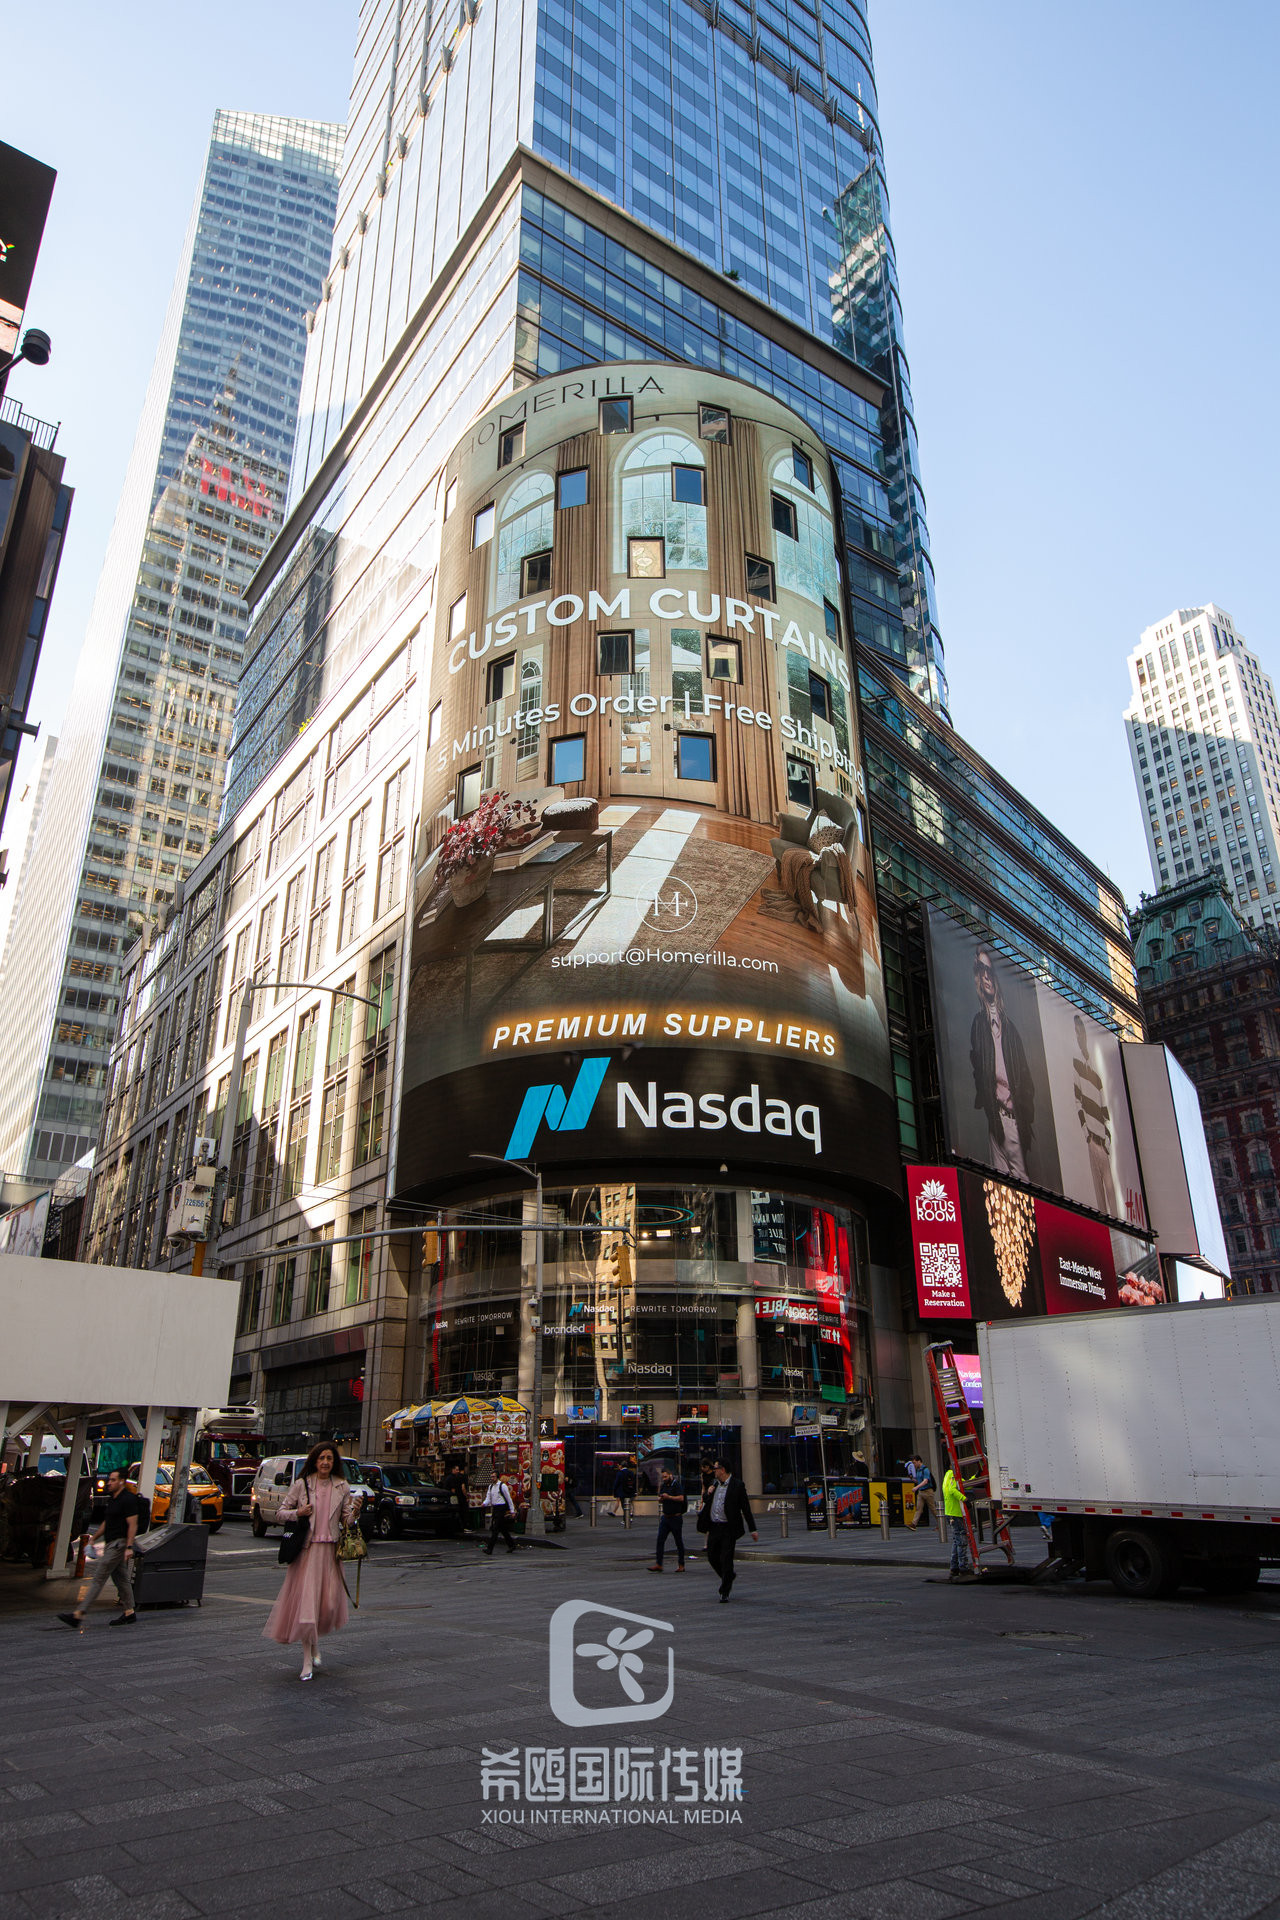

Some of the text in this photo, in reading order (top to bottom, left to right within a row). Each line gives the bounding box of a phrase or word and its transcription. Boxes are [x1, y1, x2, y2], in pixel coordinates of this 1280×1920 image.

[459, 375, 666, 461] HOMERILLA
[447, 588, 852, 694] CUSTOM CURTAINS
[437, 752, 448, 773] 5
[452, 704, 560, 756] Minutes
[570, 690, 673, 718] Order
[703, 693, 773, 731] Free
[780, 715, 866, 797] Shipping
[550, 947, 780, 974] support@Homerilla.com
[492, 1013, 837, 1057] PREMIUM SUPPLIERS
[616, 1081, 822, 1155] Nasdaq
[915, 1199, 956, 1213] LOTUS
[917, 1210, 957, 1222] ROOM
[1125, 1188, 1146, 1230] H&M
[1059, 1257, 1102, 1280] East-Meets-West
[931, 1289, 951, 1298] Make
[1059, 1273, 1107, 1300] Immersive Dining
[583, 1305, 718, 1315] Nasdaq REWRITE TOMORROW
[924, 1298, 966, 1307] Reservation
[477, 1311, 513, 1322] TOMORROW
[544, 1322, 613, 1335] brandedci
[627, 1362, 673, 1376] Nasdaq
[836, 1487, 863, 1515] AMAZE
